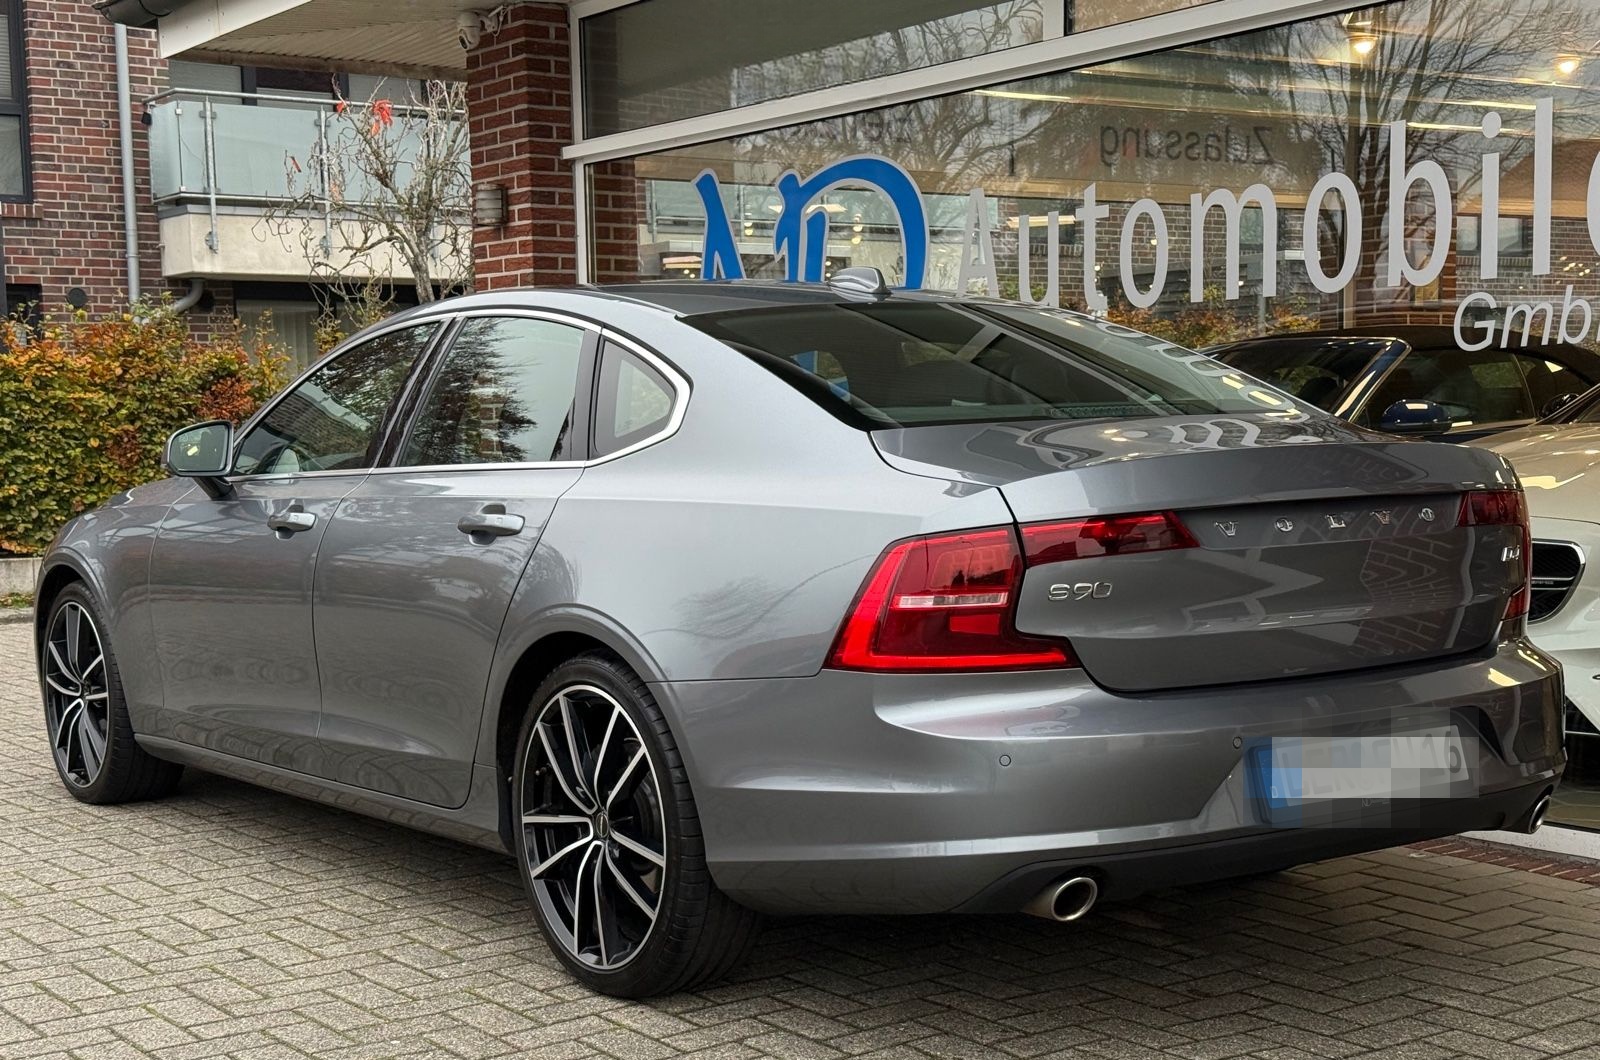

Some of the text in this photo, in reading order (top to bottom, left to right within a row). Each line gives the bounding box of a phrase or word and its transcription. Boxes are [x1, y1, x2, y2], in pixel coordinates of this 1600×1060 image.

[957, 97, 1600, 318] Automobil
[1453, 284, 1600, 352] Gmb
[1214, 507, 1436, 537] VOLVO
[1048, 581, 1113, 601] S90
